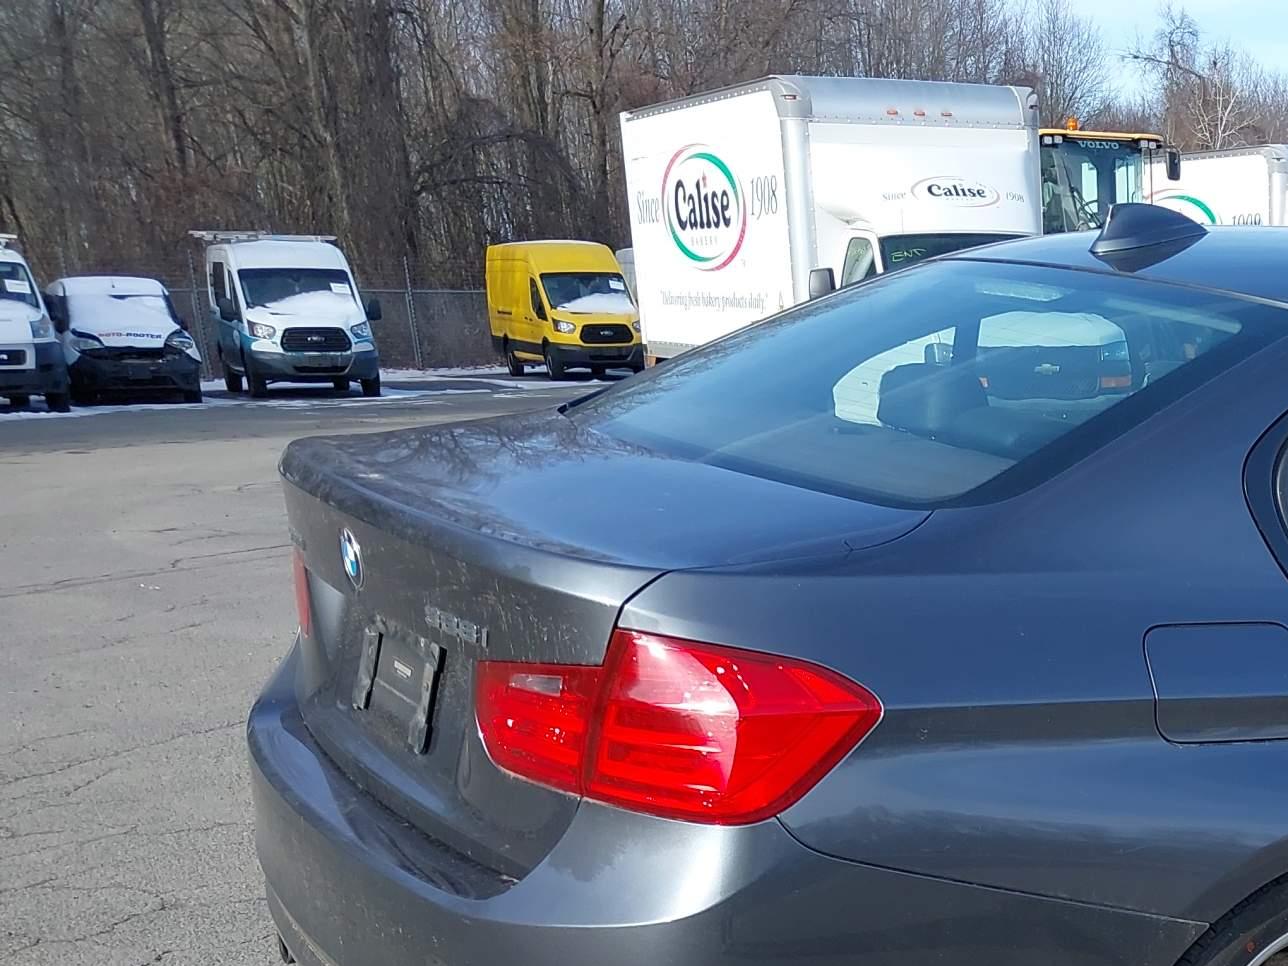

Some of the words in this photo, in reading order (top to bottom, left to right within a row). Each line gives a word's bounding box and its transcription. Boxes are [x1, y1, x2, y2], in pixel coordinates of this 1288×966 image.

[1078, 141, 1120, 149] VOLVO
[927, 183, 988, 198] Calise
[637, 191, 660, 224] Since
[674, 172, 731, 231] Calise
[750, 175, 778, 220] 1908
